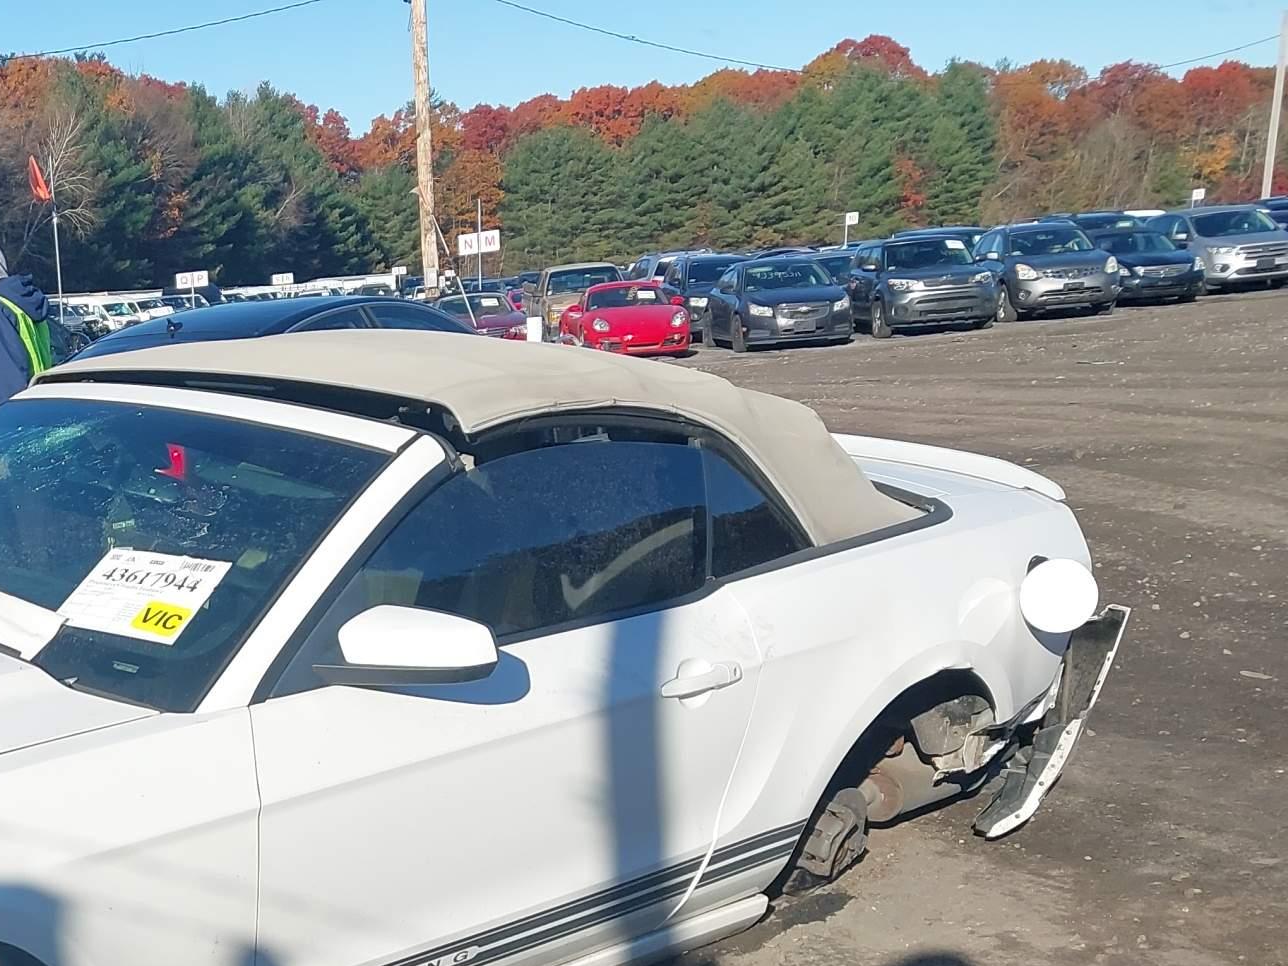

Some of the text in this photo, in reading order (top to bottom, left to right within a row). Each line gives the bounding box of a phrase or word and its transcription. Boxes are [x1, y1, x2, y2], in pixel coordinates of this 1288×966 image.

[464, 235, 496, 250] N M
[197, 275, 204, 283] P
[102, 567, 203, 592] 43617944
[142, 607, 183, 630] VIC
